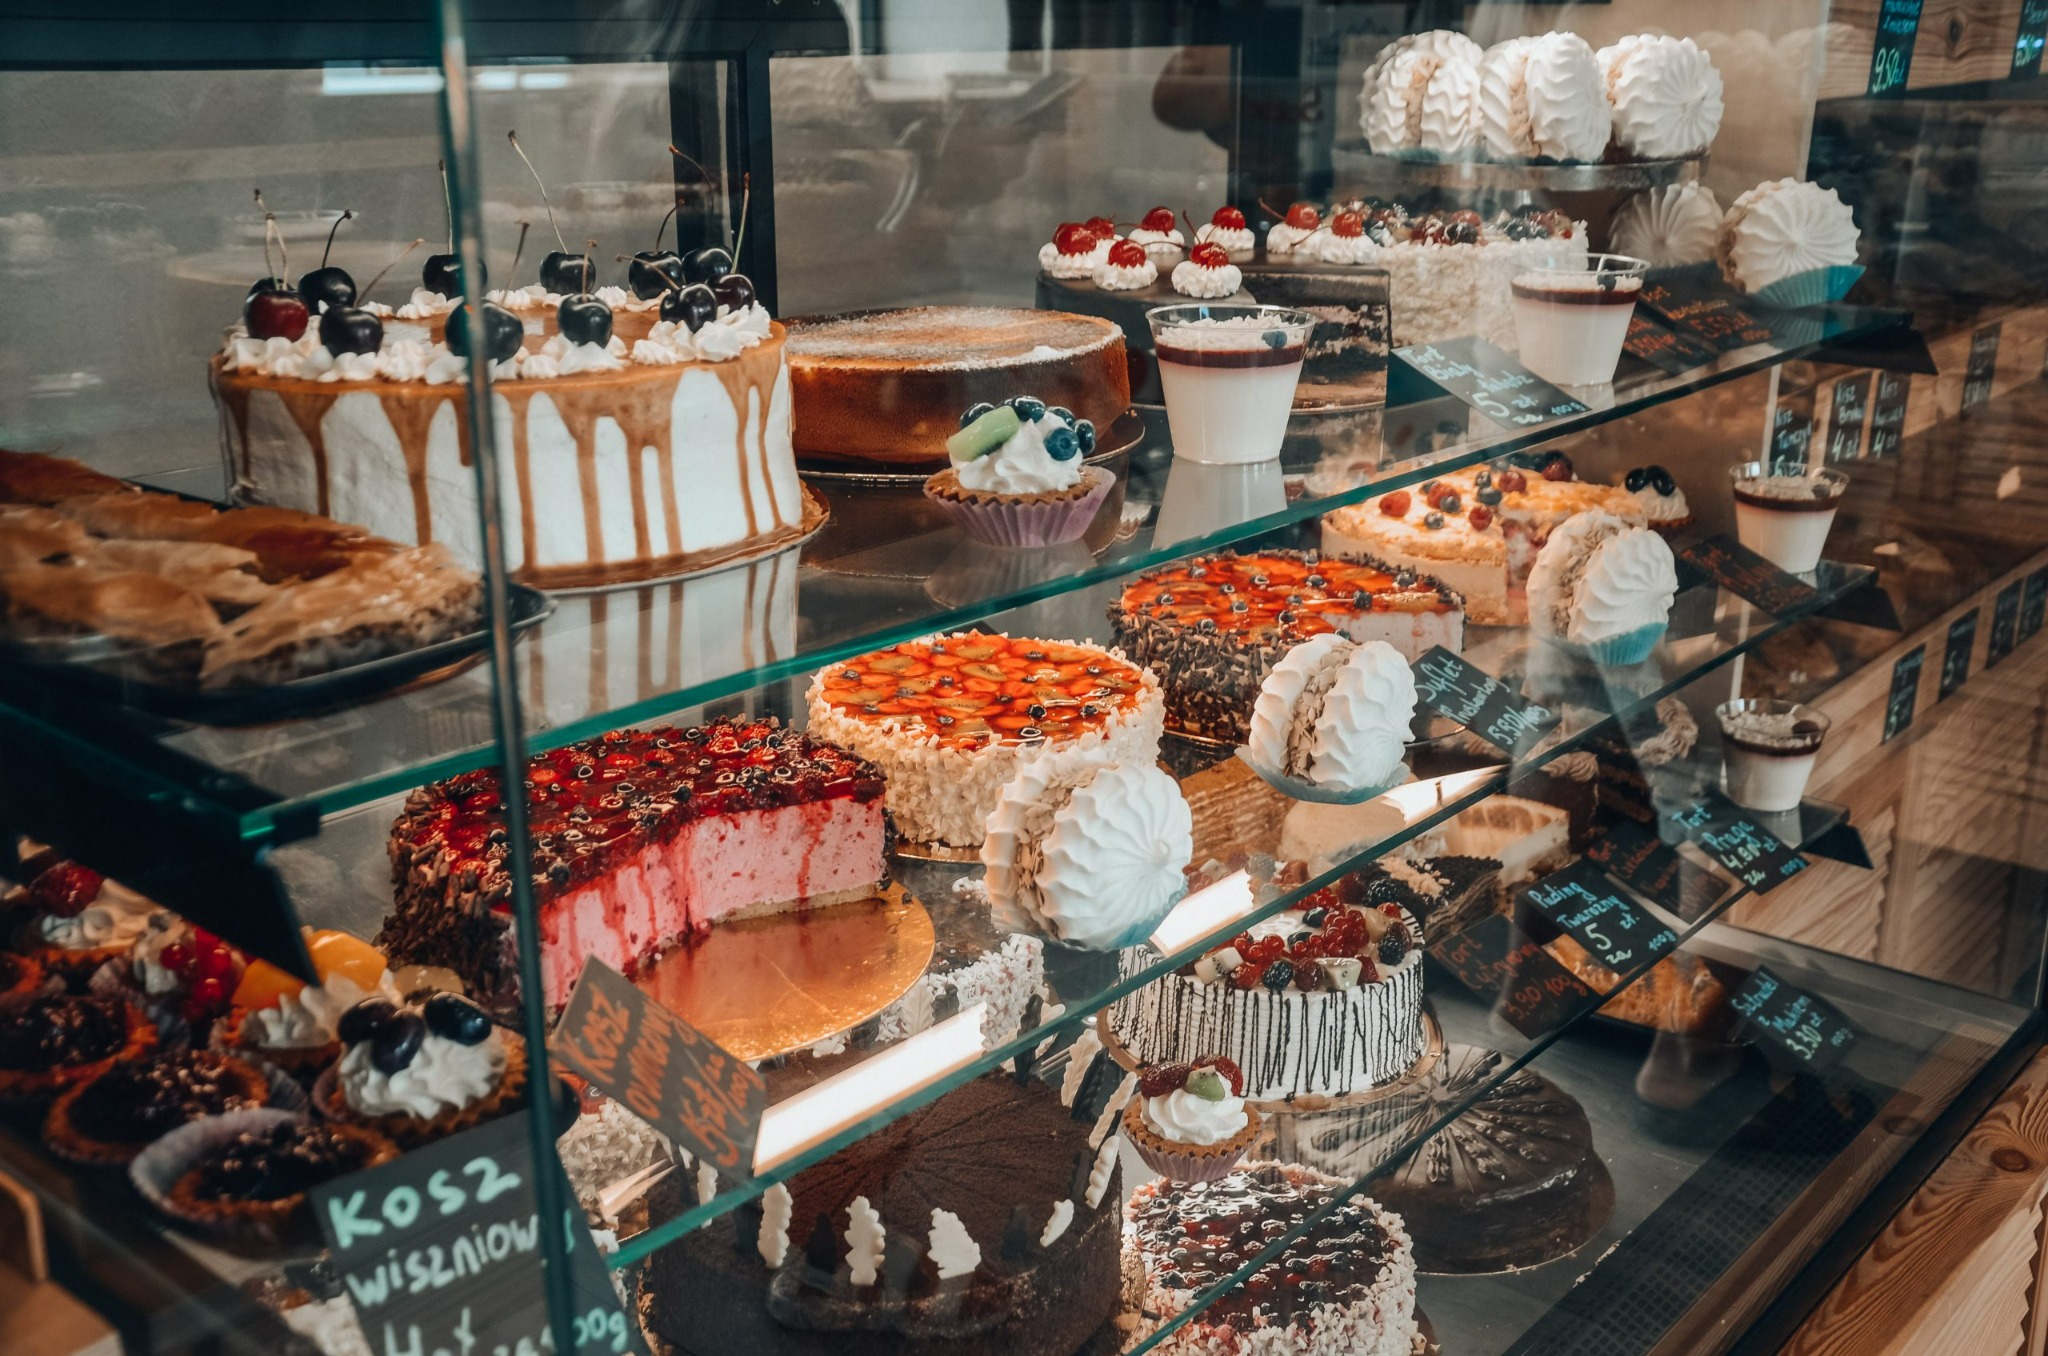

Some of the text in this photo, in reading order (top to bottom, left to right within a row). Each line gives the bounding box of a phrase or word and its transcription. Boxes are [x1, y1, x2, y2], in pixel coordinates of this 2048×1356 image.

[1398, 345, 1445, 364] Tort
[1472, 392, 1510, 417] 5
[1671, 803, 1712, 830] Tort
[1701, 821, 1762, 851] Praga
[1528, 882, 1597, 908] Puding
[1584, 923, 1612, 950] 5
[1605, 930, 1677, 964] za 100g
[1429, 933, 1483, 970] Tort
[1785, 1024, 1822, 1060] 3.30
